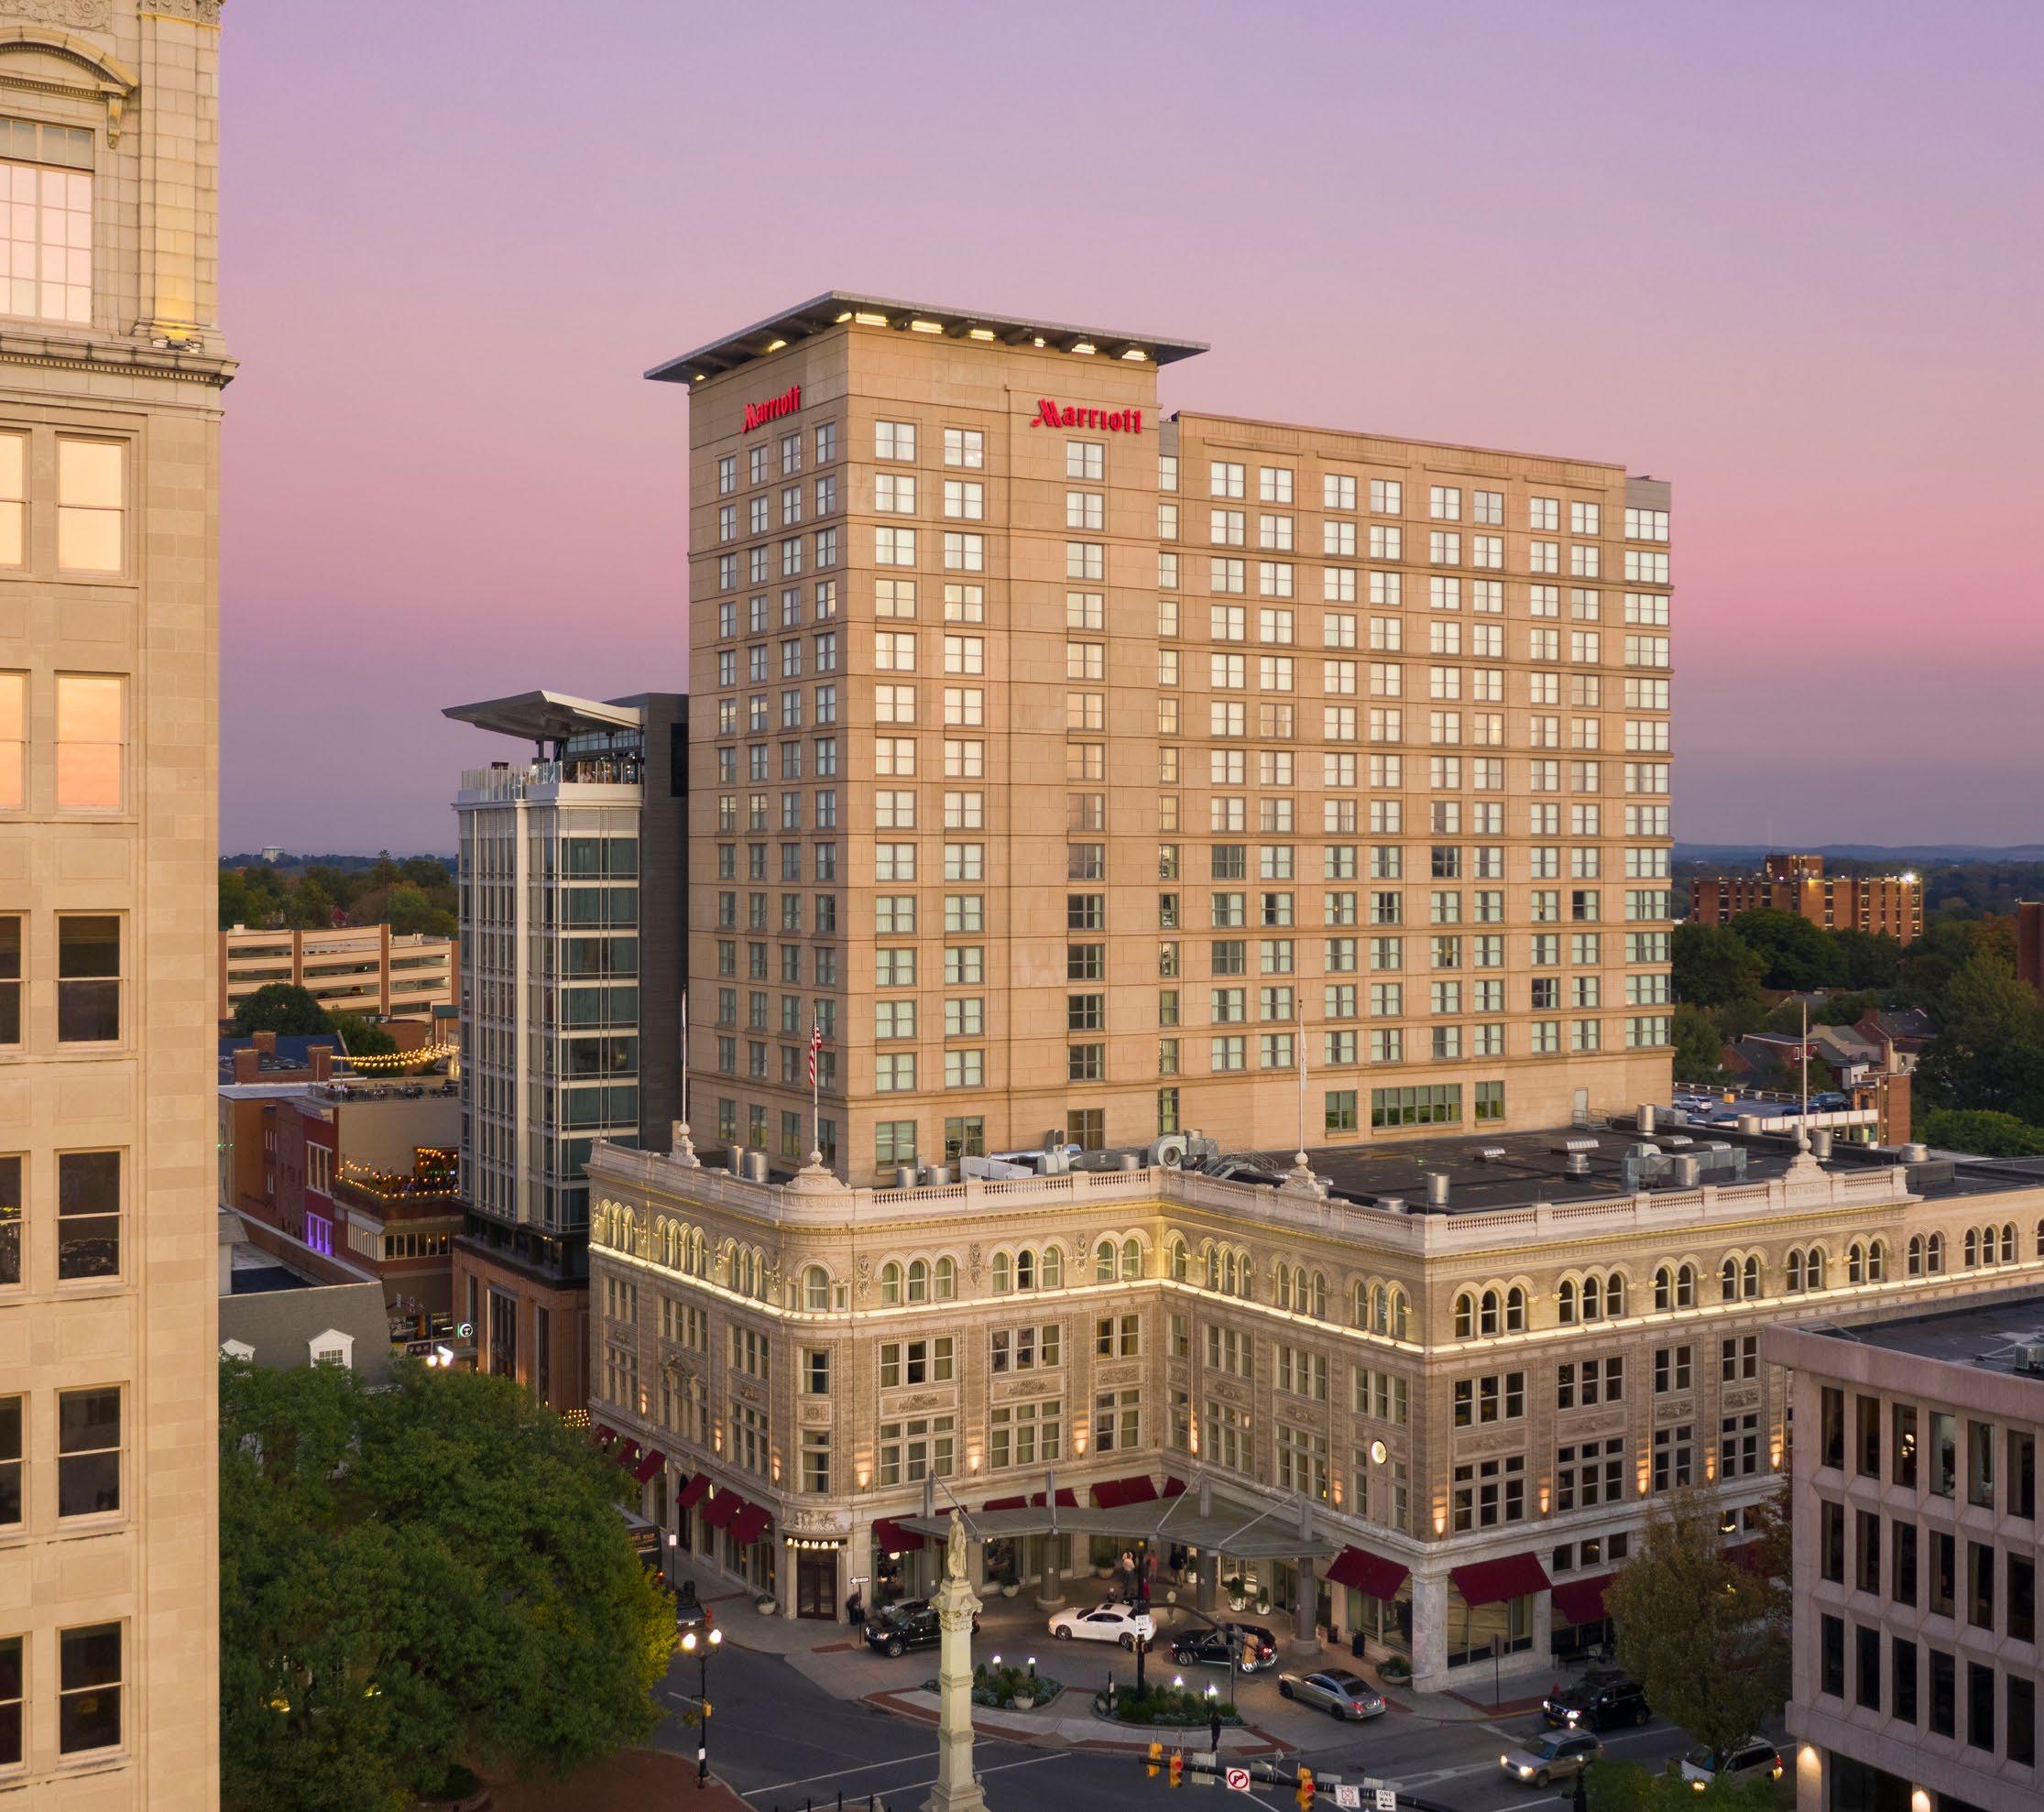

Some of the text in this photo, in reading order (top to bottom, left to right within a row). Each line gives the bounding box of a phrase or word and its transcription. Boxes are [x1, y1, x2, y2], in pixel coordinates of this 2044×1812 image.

[741, 385, 800, 433] Marriott
[1030, 398, 1142, 433] Marriott
[787, 1537, 839, 1549] PLOUGH
